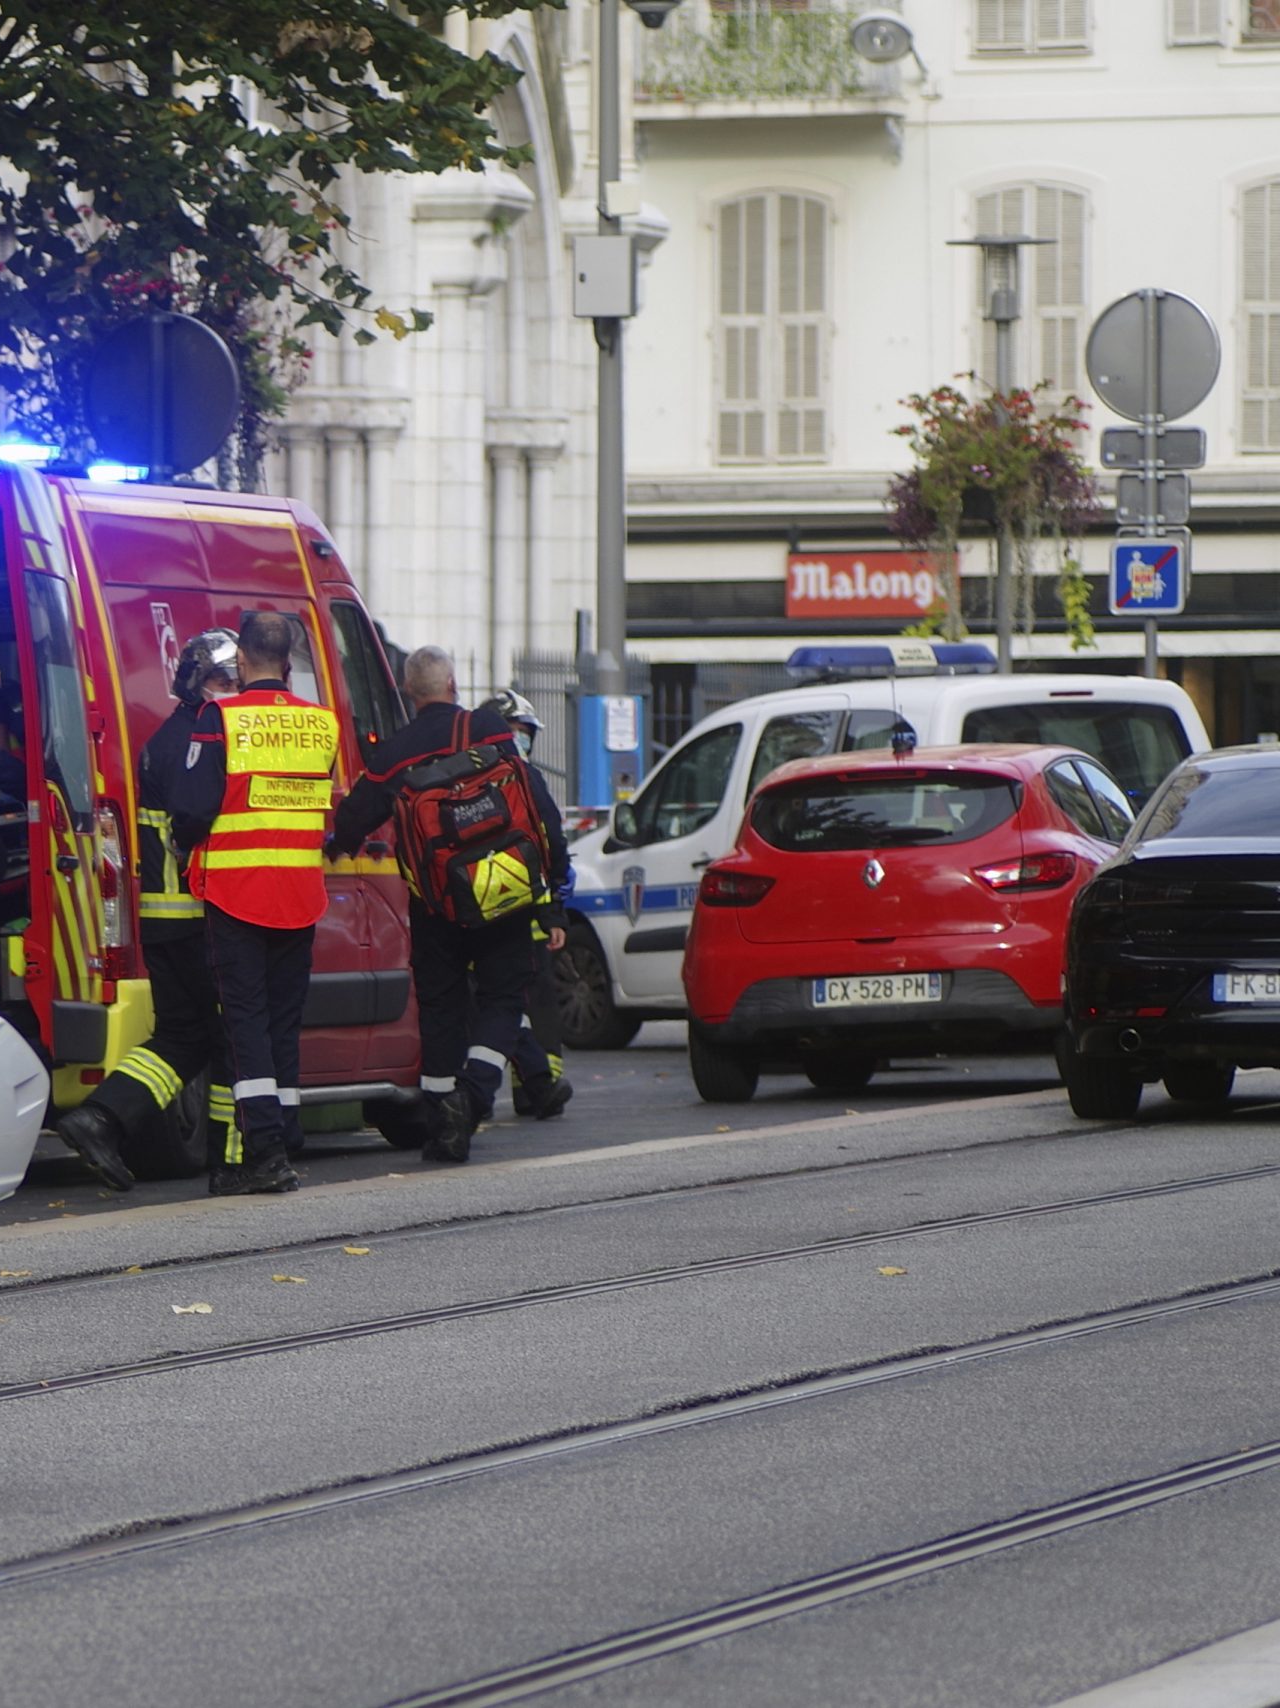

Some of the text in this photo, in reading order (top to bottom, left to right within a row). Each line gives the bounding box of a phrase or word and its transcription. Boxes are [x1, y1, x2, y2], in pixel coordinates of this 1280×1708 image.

[238, 714, 330, 731] SAPEURS
[236, 732, 334, 751] POMPIERS
[266, 780, 316, 794] INFIRMIER
[251, 794, 327, 808] COORDINATEUR
[681, 886, 699, 907] PO
[1230, 974, 1280, 995] FK-8
